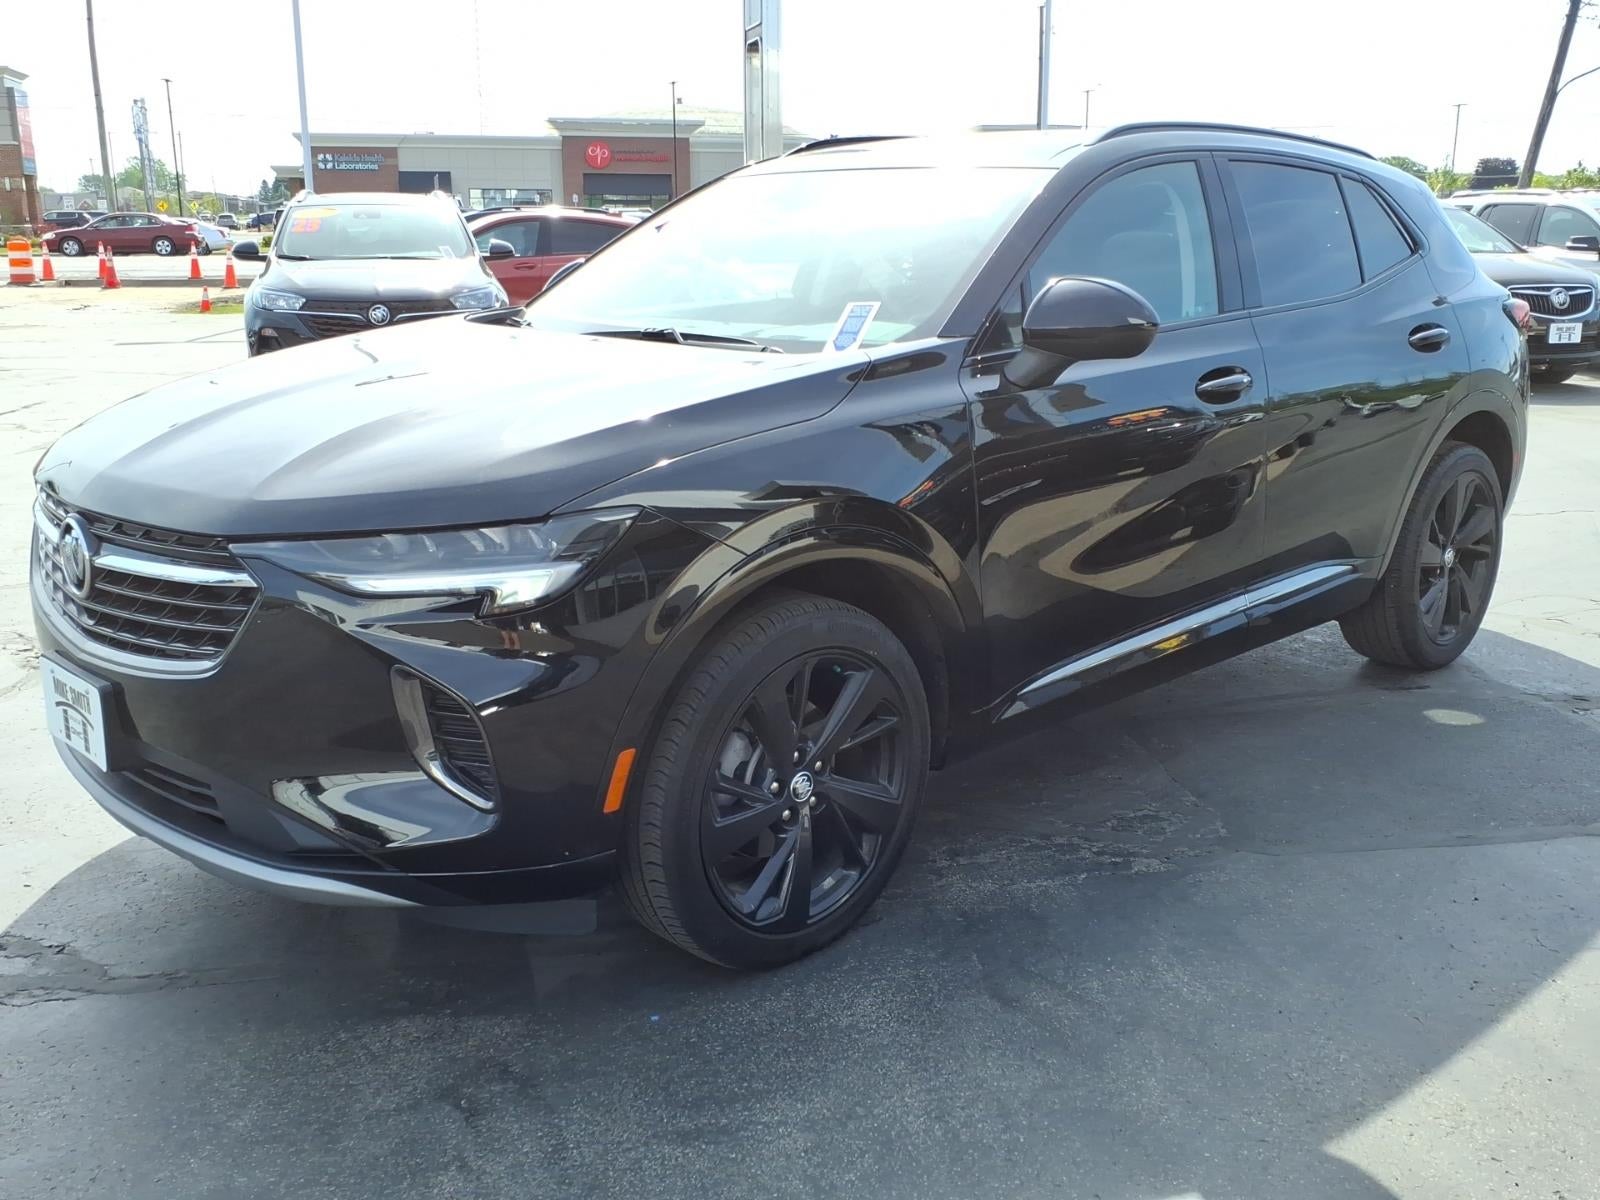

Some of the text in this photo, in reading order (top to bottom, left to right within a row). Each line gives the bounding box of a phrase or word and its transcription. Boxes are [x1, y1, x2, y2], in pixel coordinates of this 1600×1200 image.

[361, 153, 385, 163] Health
[335, 161, 379, 170] Laboratories
[52, 675, 92, 716] MIKE SMITH
